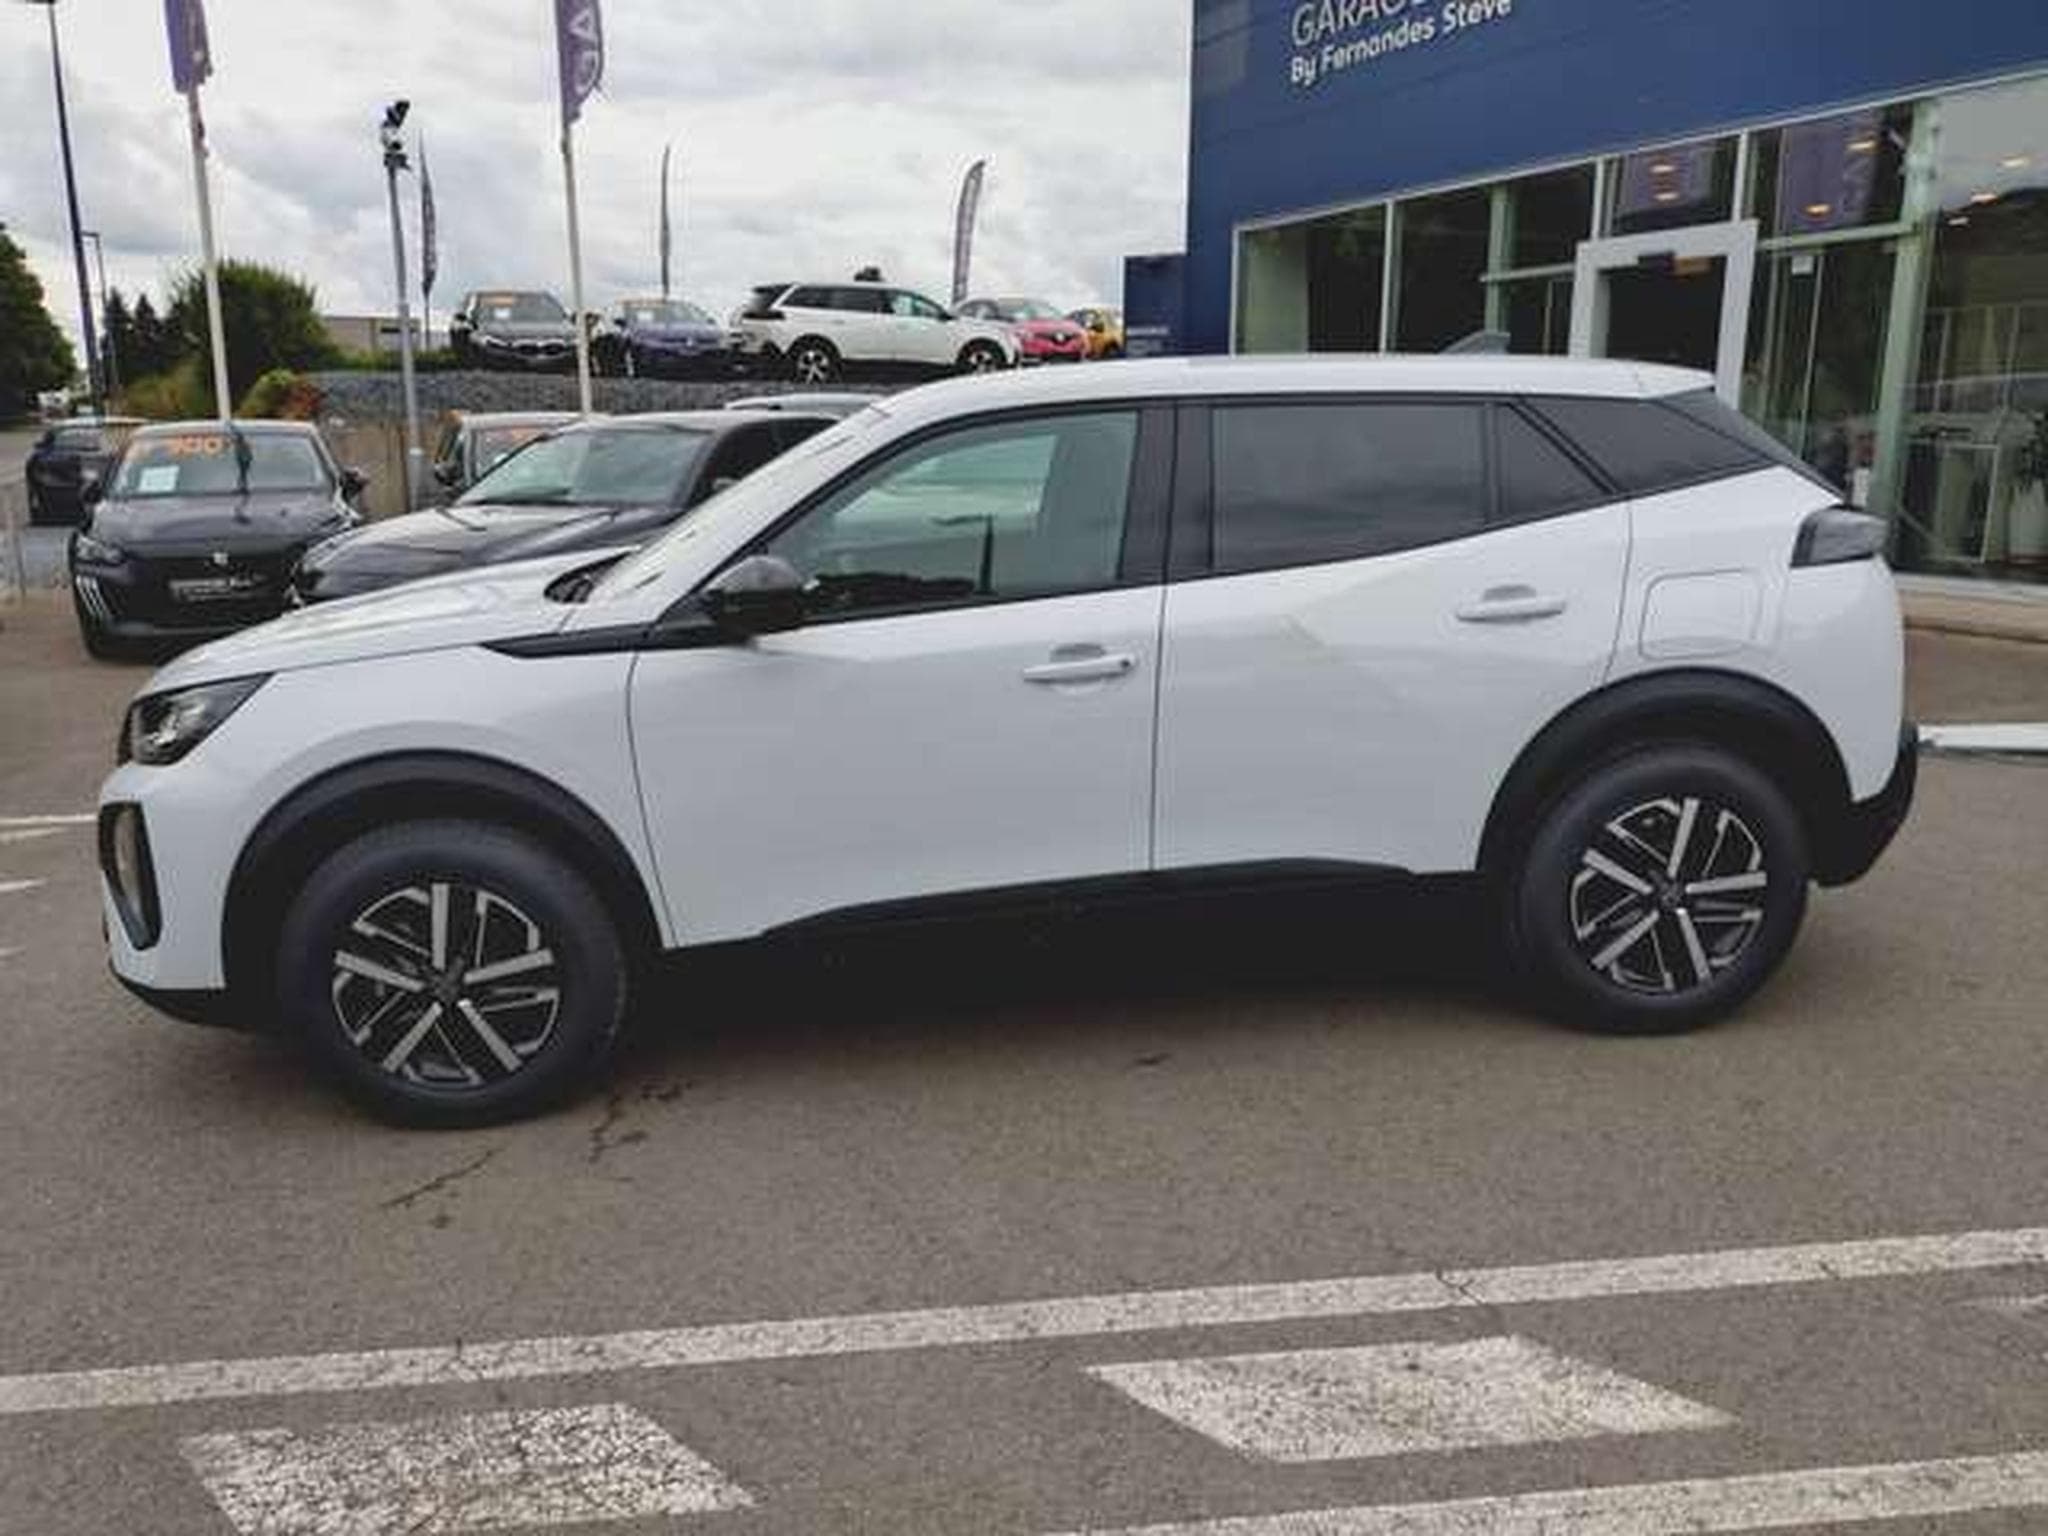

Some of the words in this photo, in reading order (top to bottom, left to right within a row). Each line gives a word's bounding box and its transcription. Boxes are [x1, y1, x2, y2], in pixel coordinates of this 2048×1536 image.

[1290, 55, 1317, 86] By
[1320, 17, 1436, 73] Fernandes
[1442, 0, 1512, 34] Steve
[1291, 0, 1426, 46] GARA
